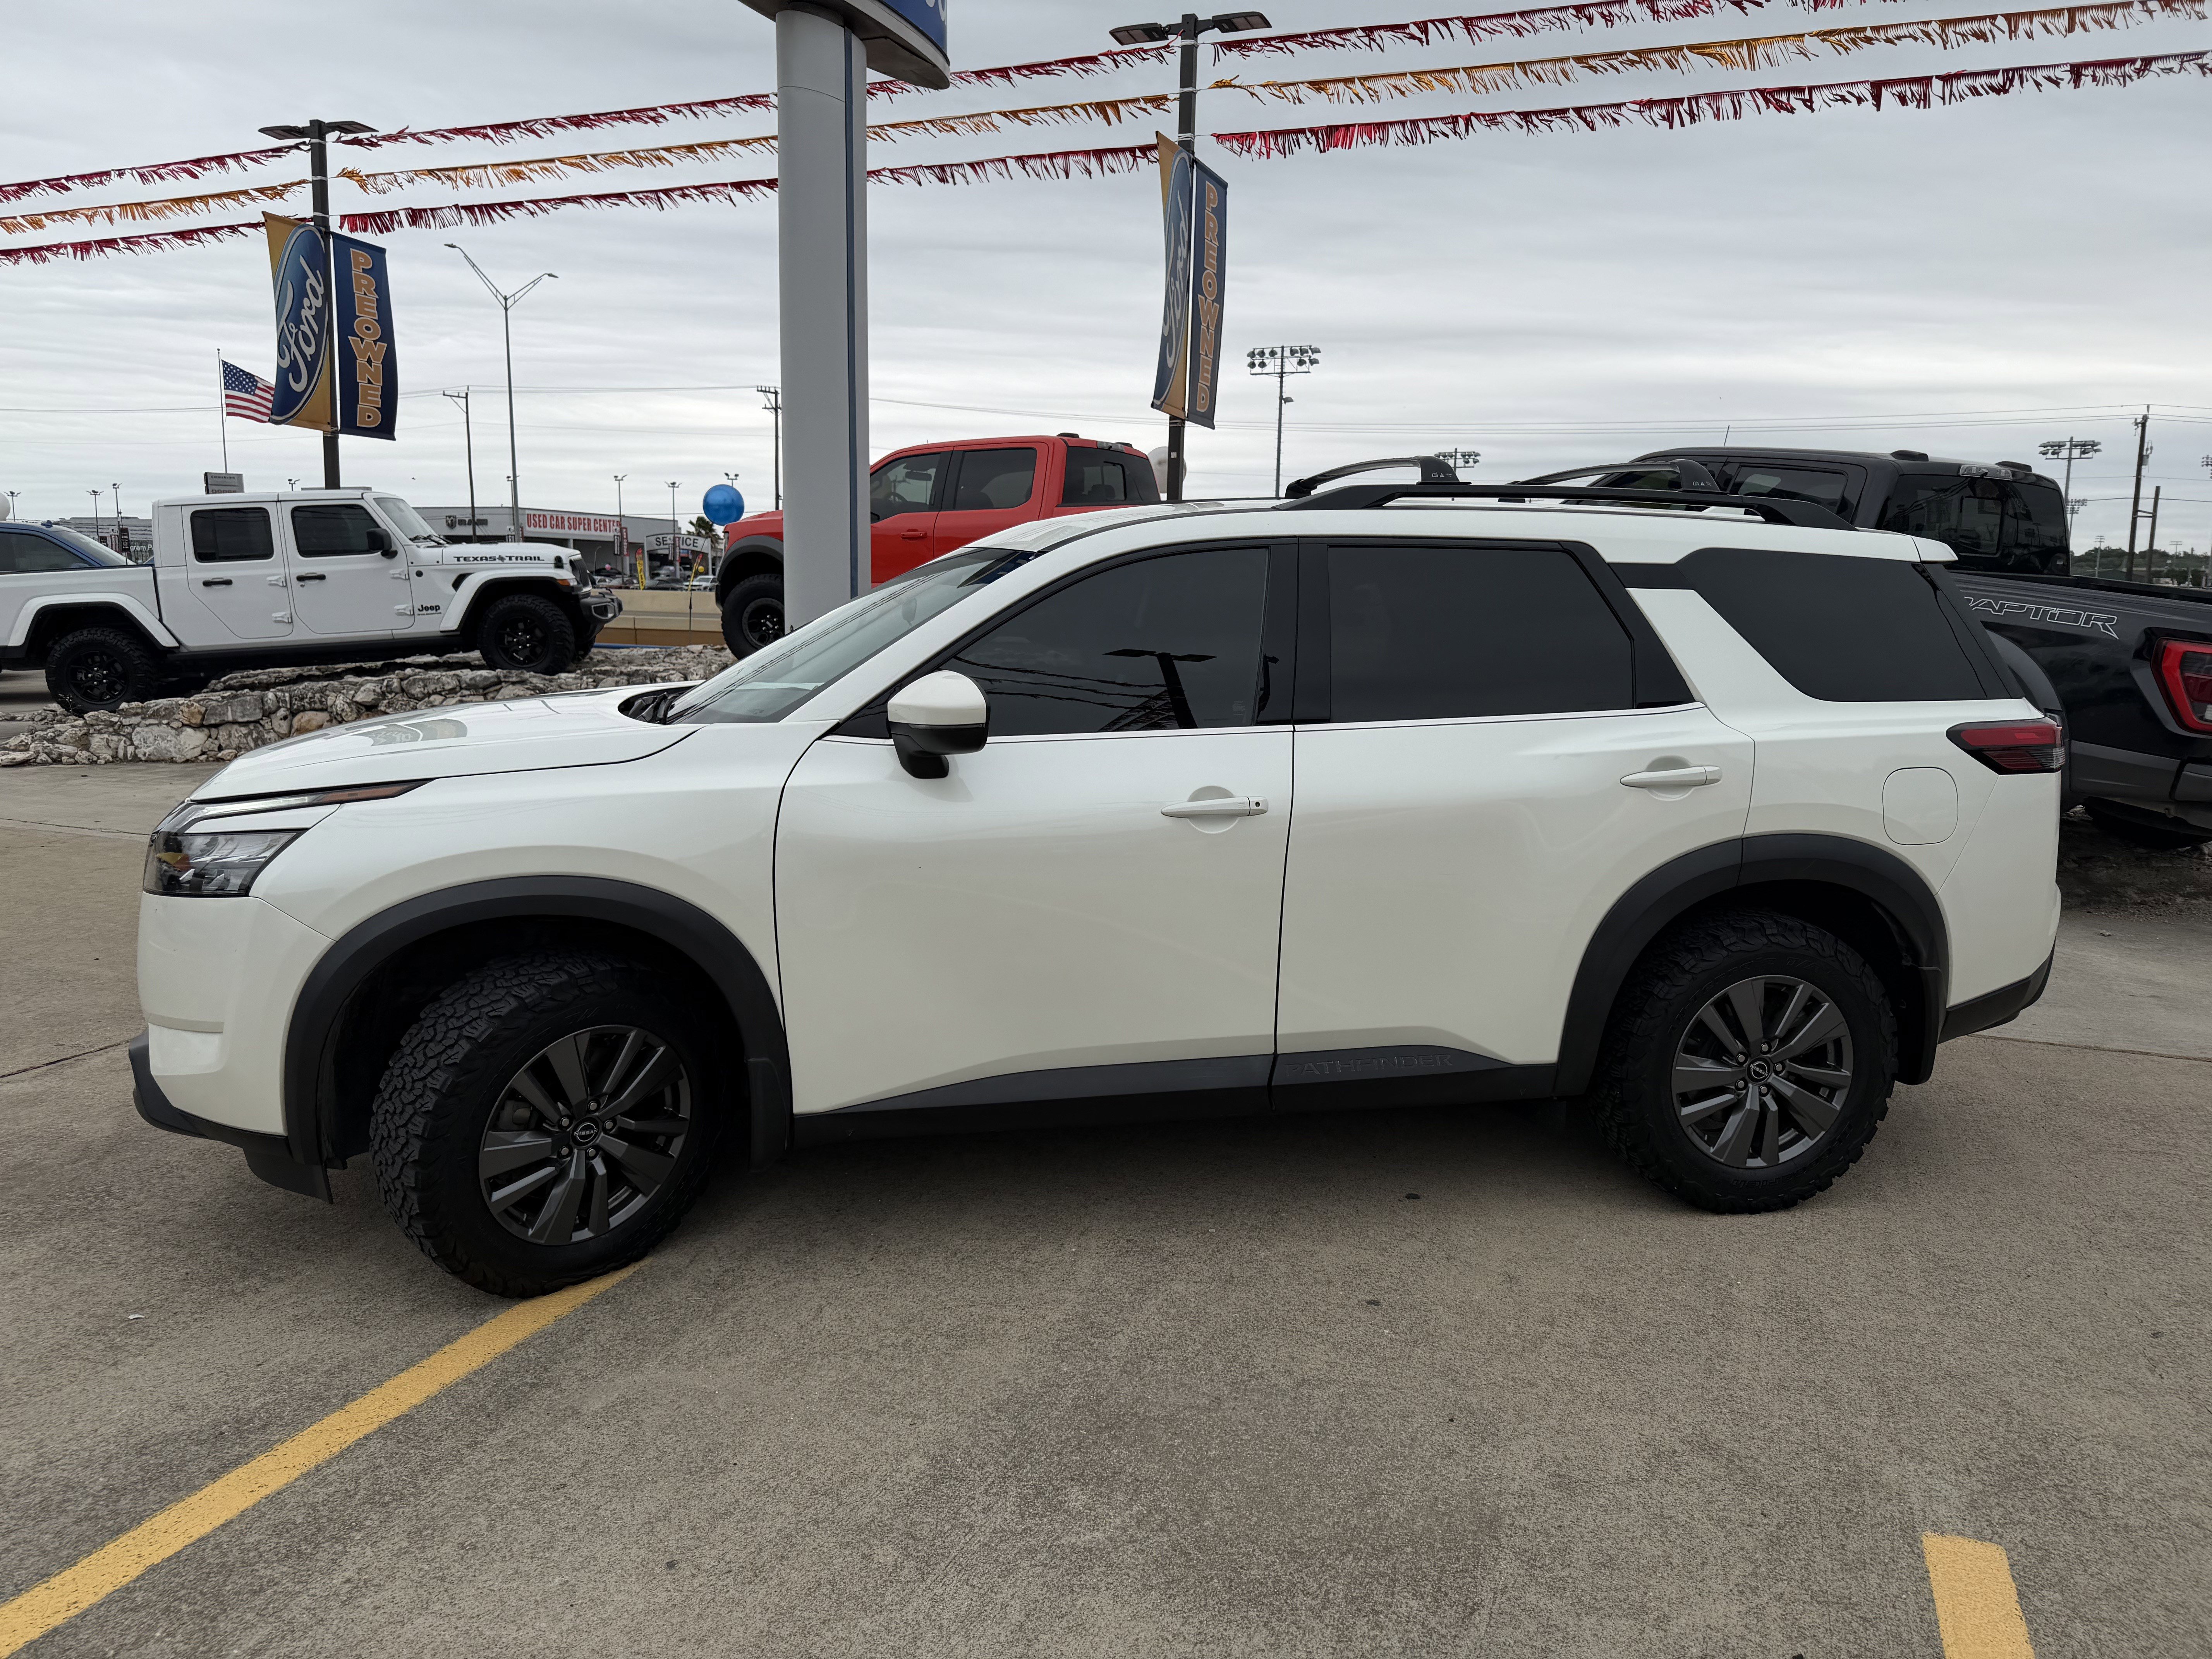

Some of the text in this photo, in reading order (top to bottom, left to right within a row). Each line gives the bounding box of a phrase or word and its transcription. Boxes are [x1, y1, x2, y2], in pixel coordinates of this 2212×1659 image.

[1163, 190, 1189, 369] Ford
[1197, 180, 1219, 412] PREOWNED
[278, 255, 324, 392] Ford
[348, 248, 387, 427] PREOWNED
[527, 513, 548, 529] USED
[550, 514, 565, 530] CAR
[567, 516, 592, 532] SUPER
[655, 536, 699, 548] SEICE
[1283, 1054, 1453, 1077] PATHFINDER
[1750, 1064, 1768, 1077] NISSAN
